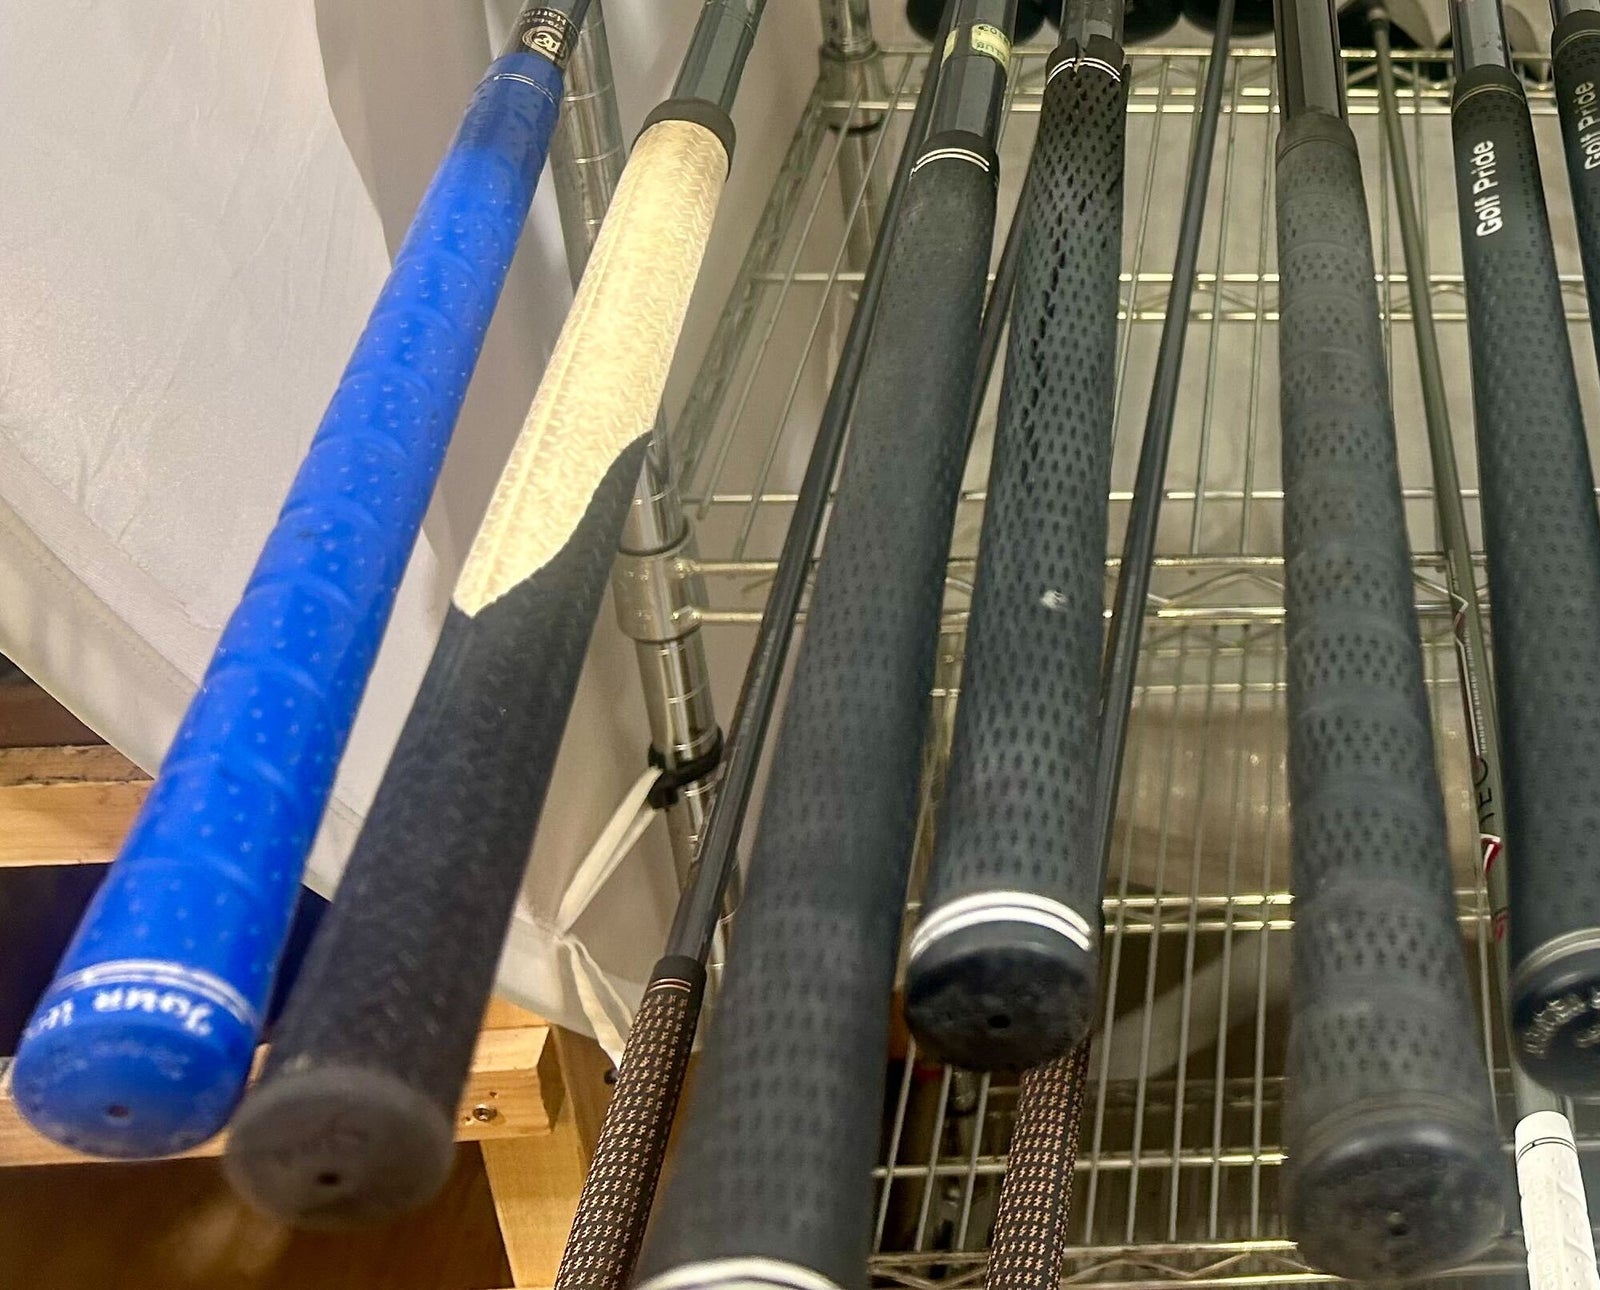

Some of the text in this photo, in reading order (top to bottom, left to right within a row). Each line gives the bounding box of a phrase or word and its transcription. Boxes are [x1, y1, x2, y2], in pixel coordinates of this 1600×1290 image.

[1572, 81, 1600, 132] Pride
[1469, 140, 1503, 237] Golf Pride
